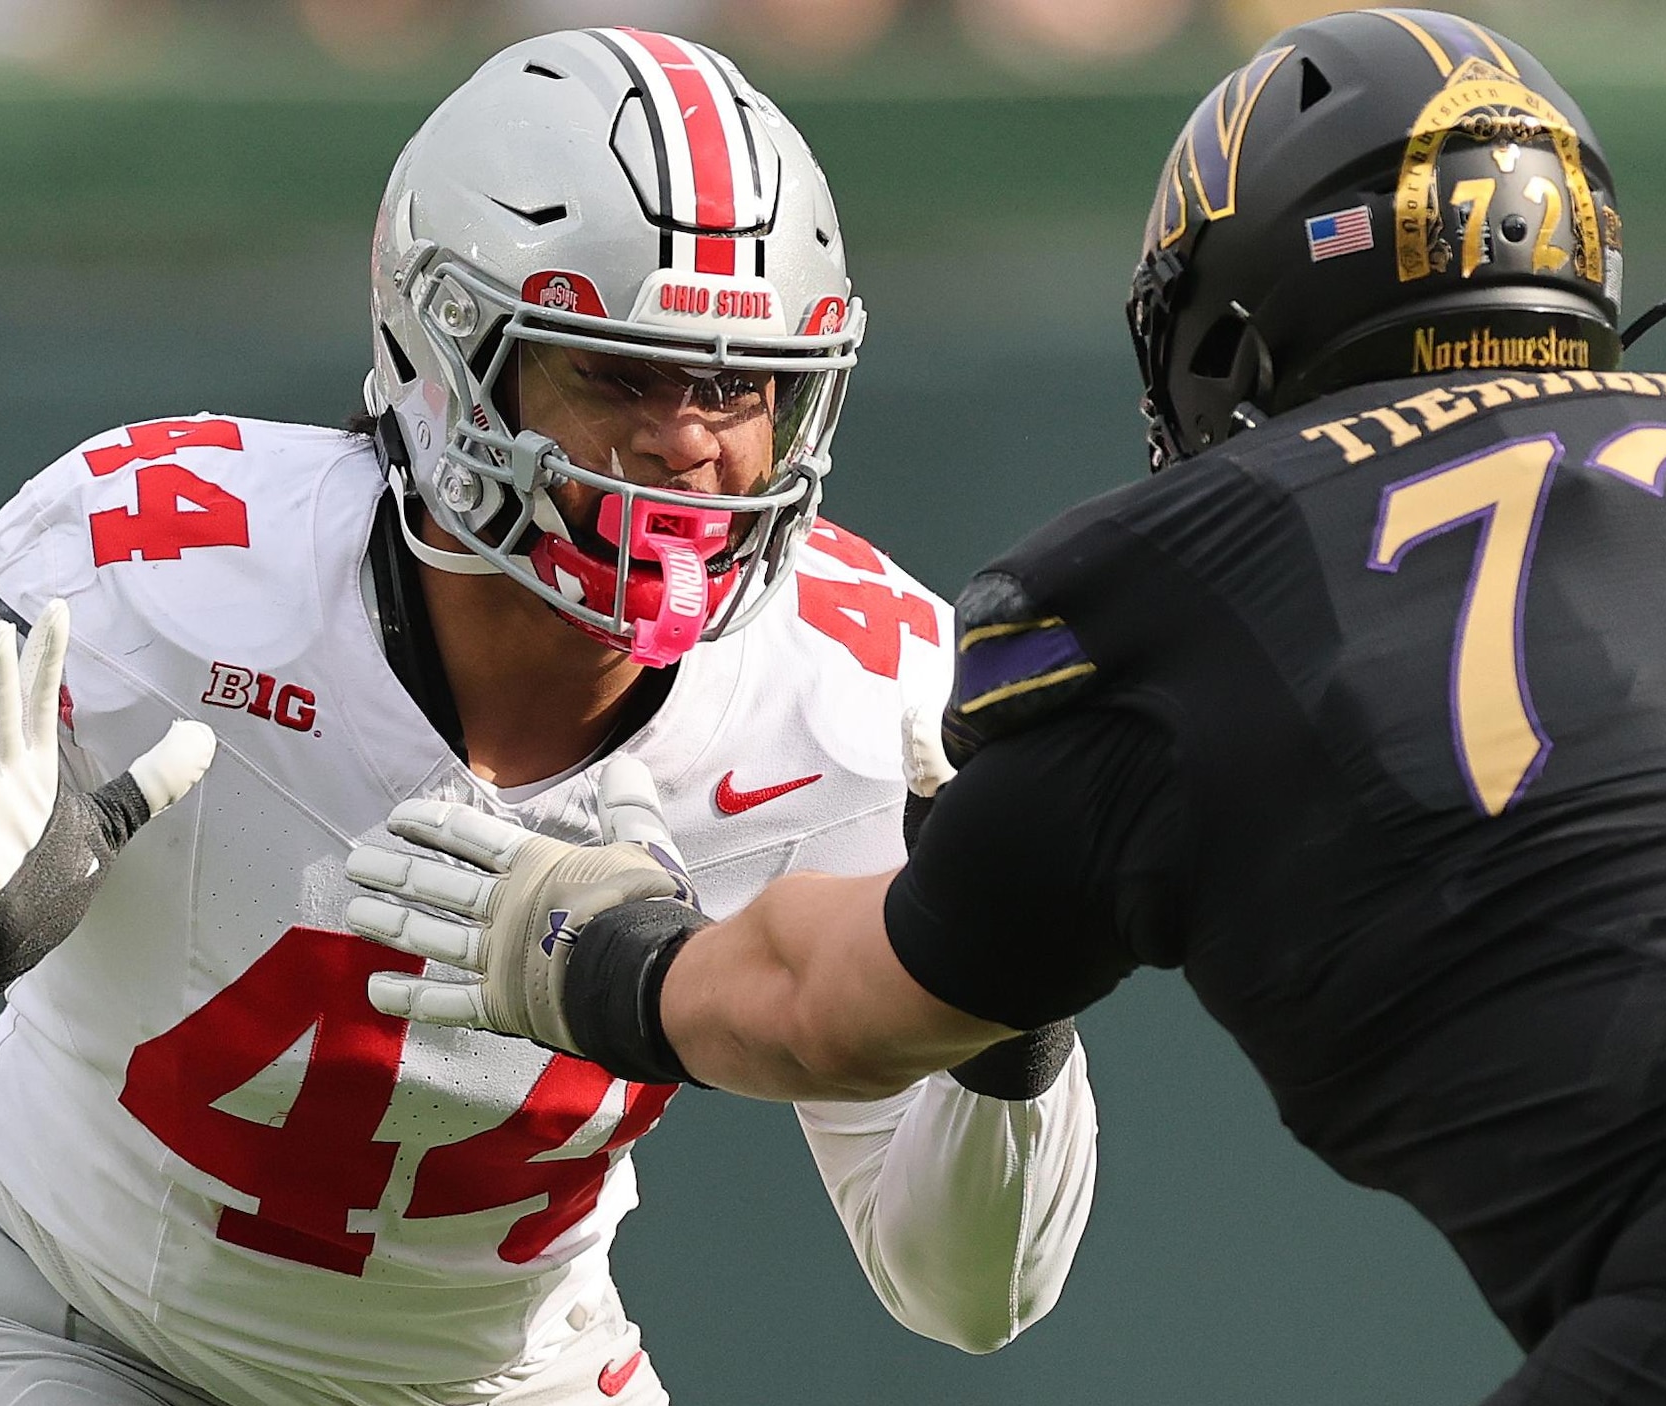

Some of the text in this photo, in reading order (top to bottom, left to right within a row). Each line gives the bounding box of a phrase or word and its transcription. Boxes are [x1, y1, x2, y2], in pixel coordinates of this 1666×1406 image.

[1450, 176, 1570, 278] 72
[660, 283, 772, 319] OHIO STATE
[1412, 326, 1589, 374] Northwestern
[83, 419, 250, 568] 44
[661, 543, 703, 617] NXTRND
[118, 925, 681, 1278] 44
